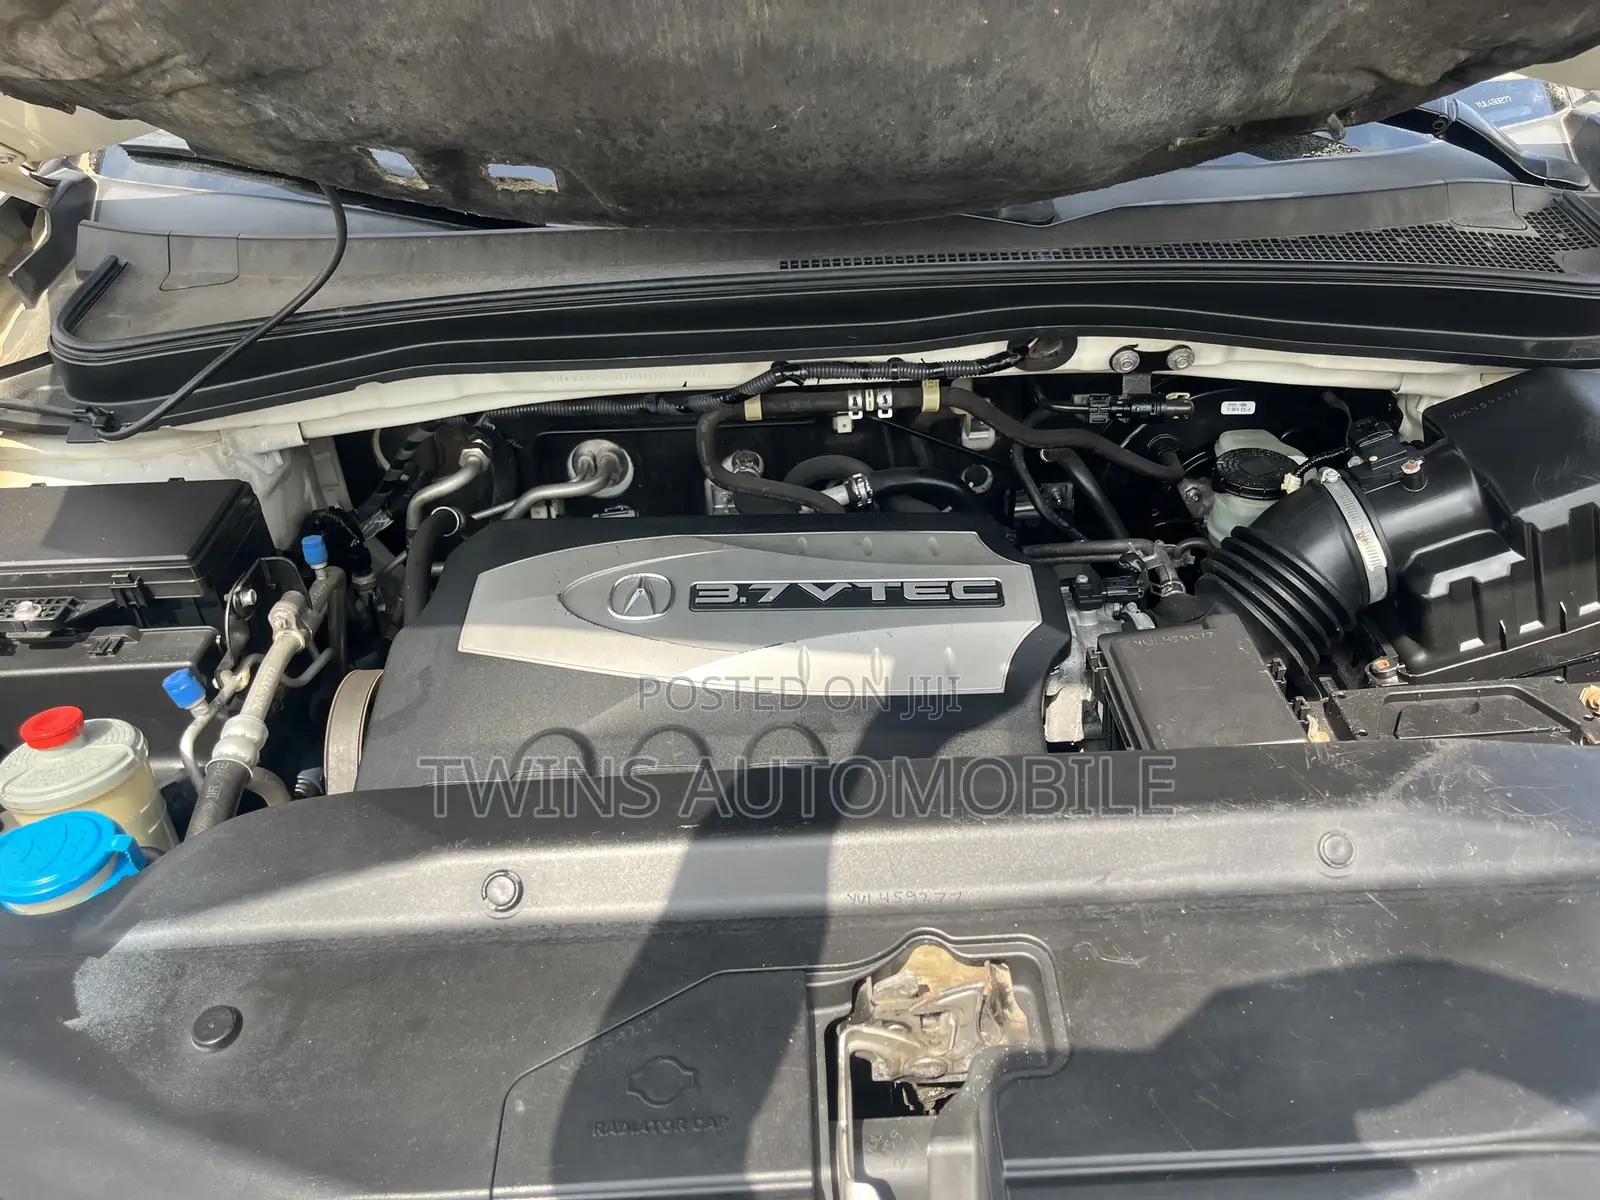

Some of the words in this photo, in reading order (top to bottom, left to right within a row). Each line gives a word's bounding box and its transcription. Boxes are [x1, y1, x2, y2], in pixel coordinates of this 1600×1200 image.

[797, 580, 998, 604] VTEC
[591, 1117, 686, 1137] RADIATOR
[691, 1114, 730, 1132] CAP
